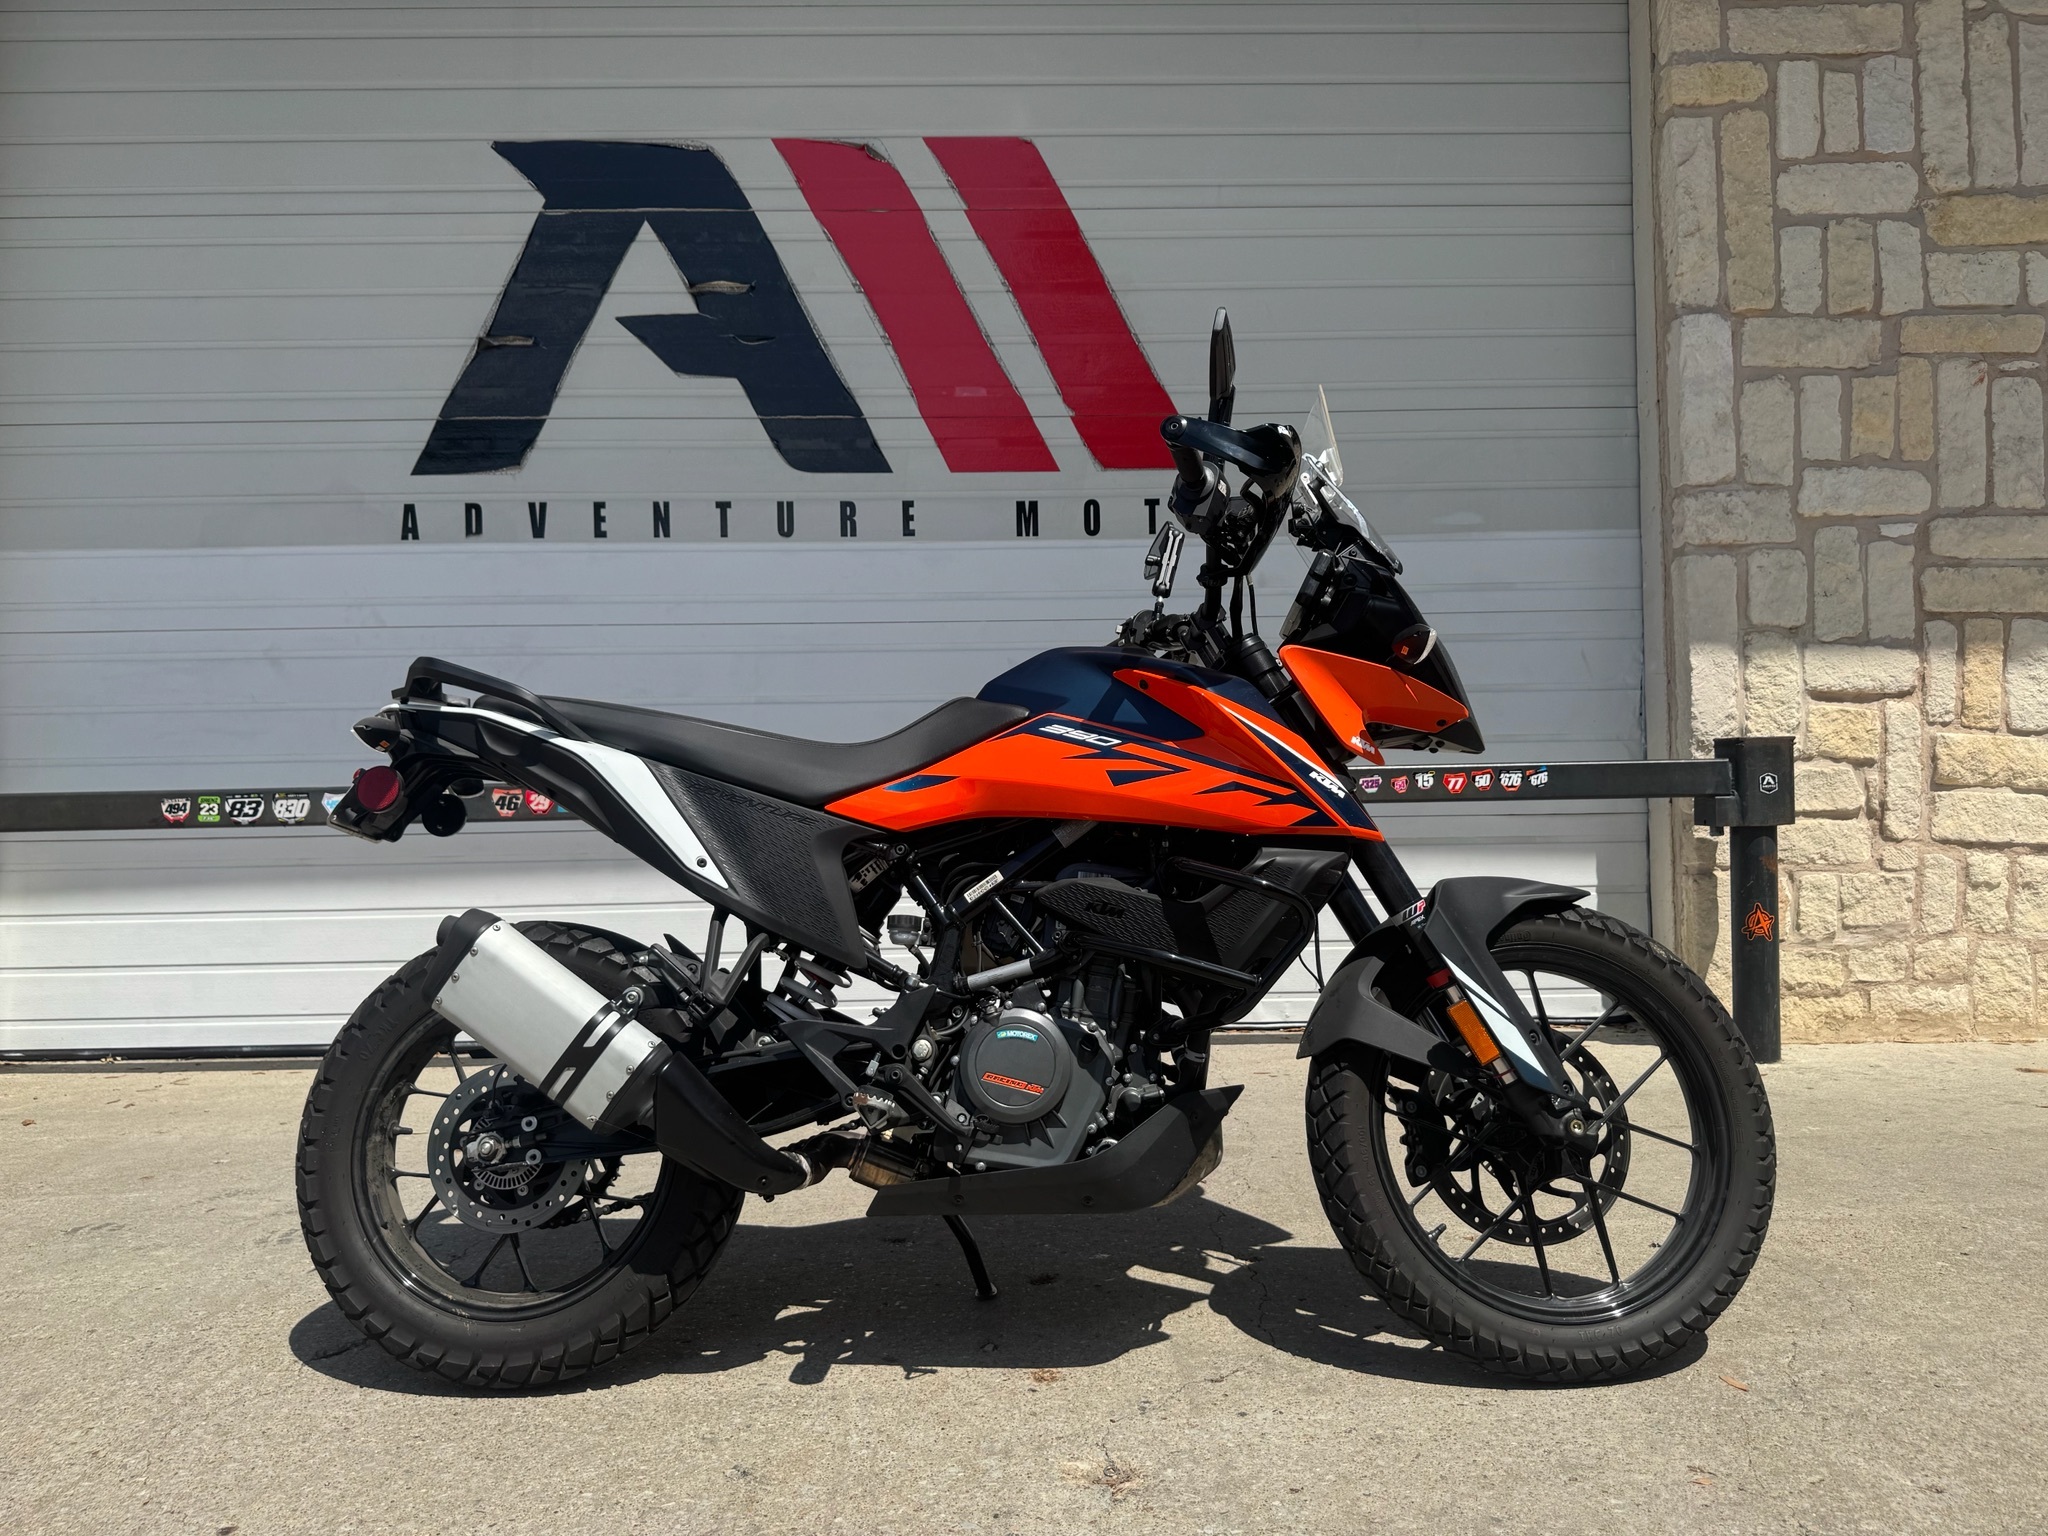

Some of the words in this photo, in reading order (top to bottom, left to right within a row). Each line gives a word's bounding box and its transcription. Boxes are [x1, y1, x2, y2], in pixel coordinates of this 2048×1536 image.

[401, 500, 916, 541] ADVENTURE
[1016, 498, 1161, 538] MOT
[1038, 724, 1123, 746] 390
[1350, 735, 1376, 754] KTM
[1308, 770, 1346, 799] KTM
[1415, 773, 1433, 788] 15
[1447, 777, 1464, 790] 77
[1474, 773, 1491, 788] 50
[164, 802, 188, 815] 494
[199, 803, 219, 816] 23
[228, 800, 263, 818] 83
[275, 799, 310, 818] 830
[494, 794, 521, 812] 46
[1006, 1030, 1037, 1042] MOTOREX
